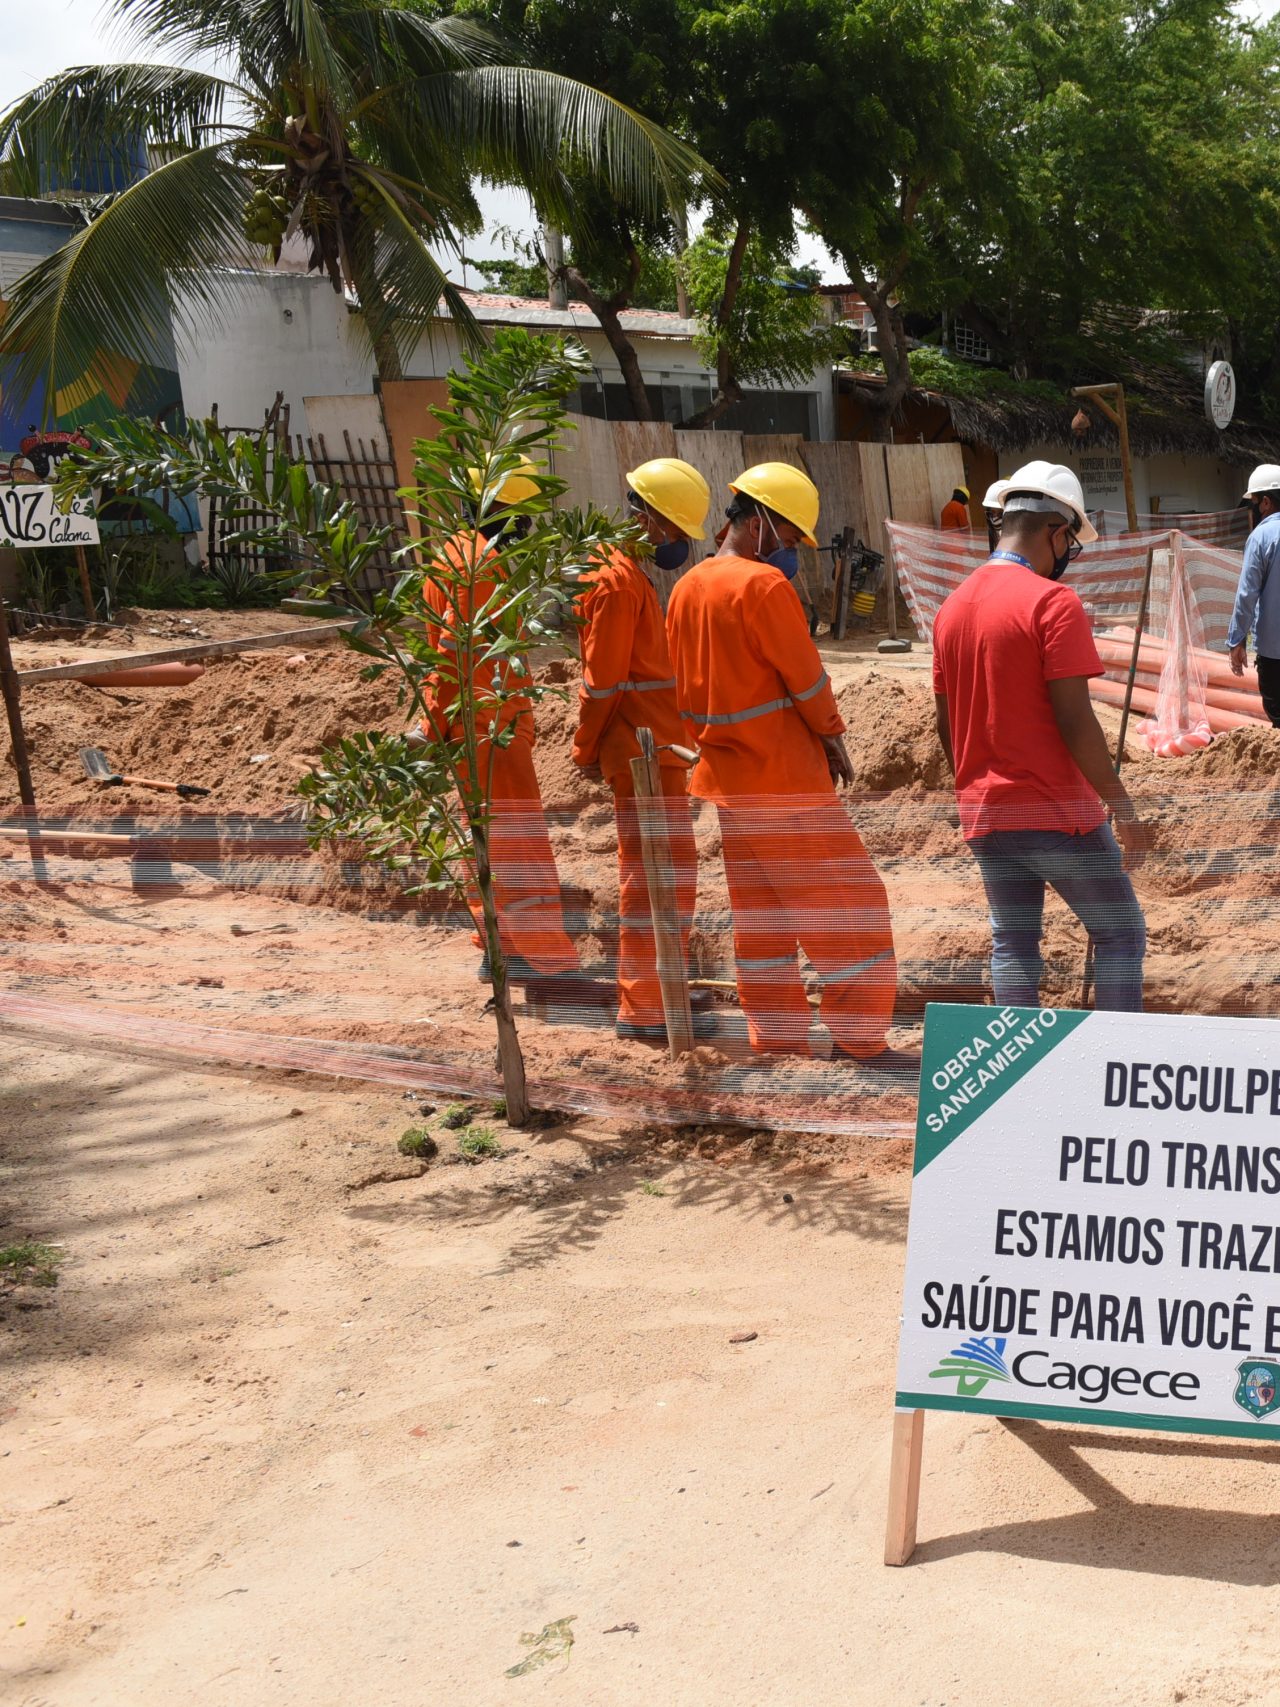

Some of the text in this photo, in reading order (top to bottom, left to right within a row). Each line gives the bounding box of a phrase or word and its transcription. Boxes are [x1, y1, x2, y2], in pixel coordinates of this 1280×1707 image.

[926, 1008, 1057, 1132] SANEAMENTO
[932, 1007, 1020, 1090] OBRA DE
[1059, 1136, 1150, 1186] PELO
[995, 1208, 1165, 1266] ESTAMOS
[922, 1275, 1040, 1335] SAÚDE
[1050, 1290, 1144, 1344] PARA
[1158, 1293, 1253, 1351] VOCÊ
[1012, 1351, 1200, 1403] Cagece
